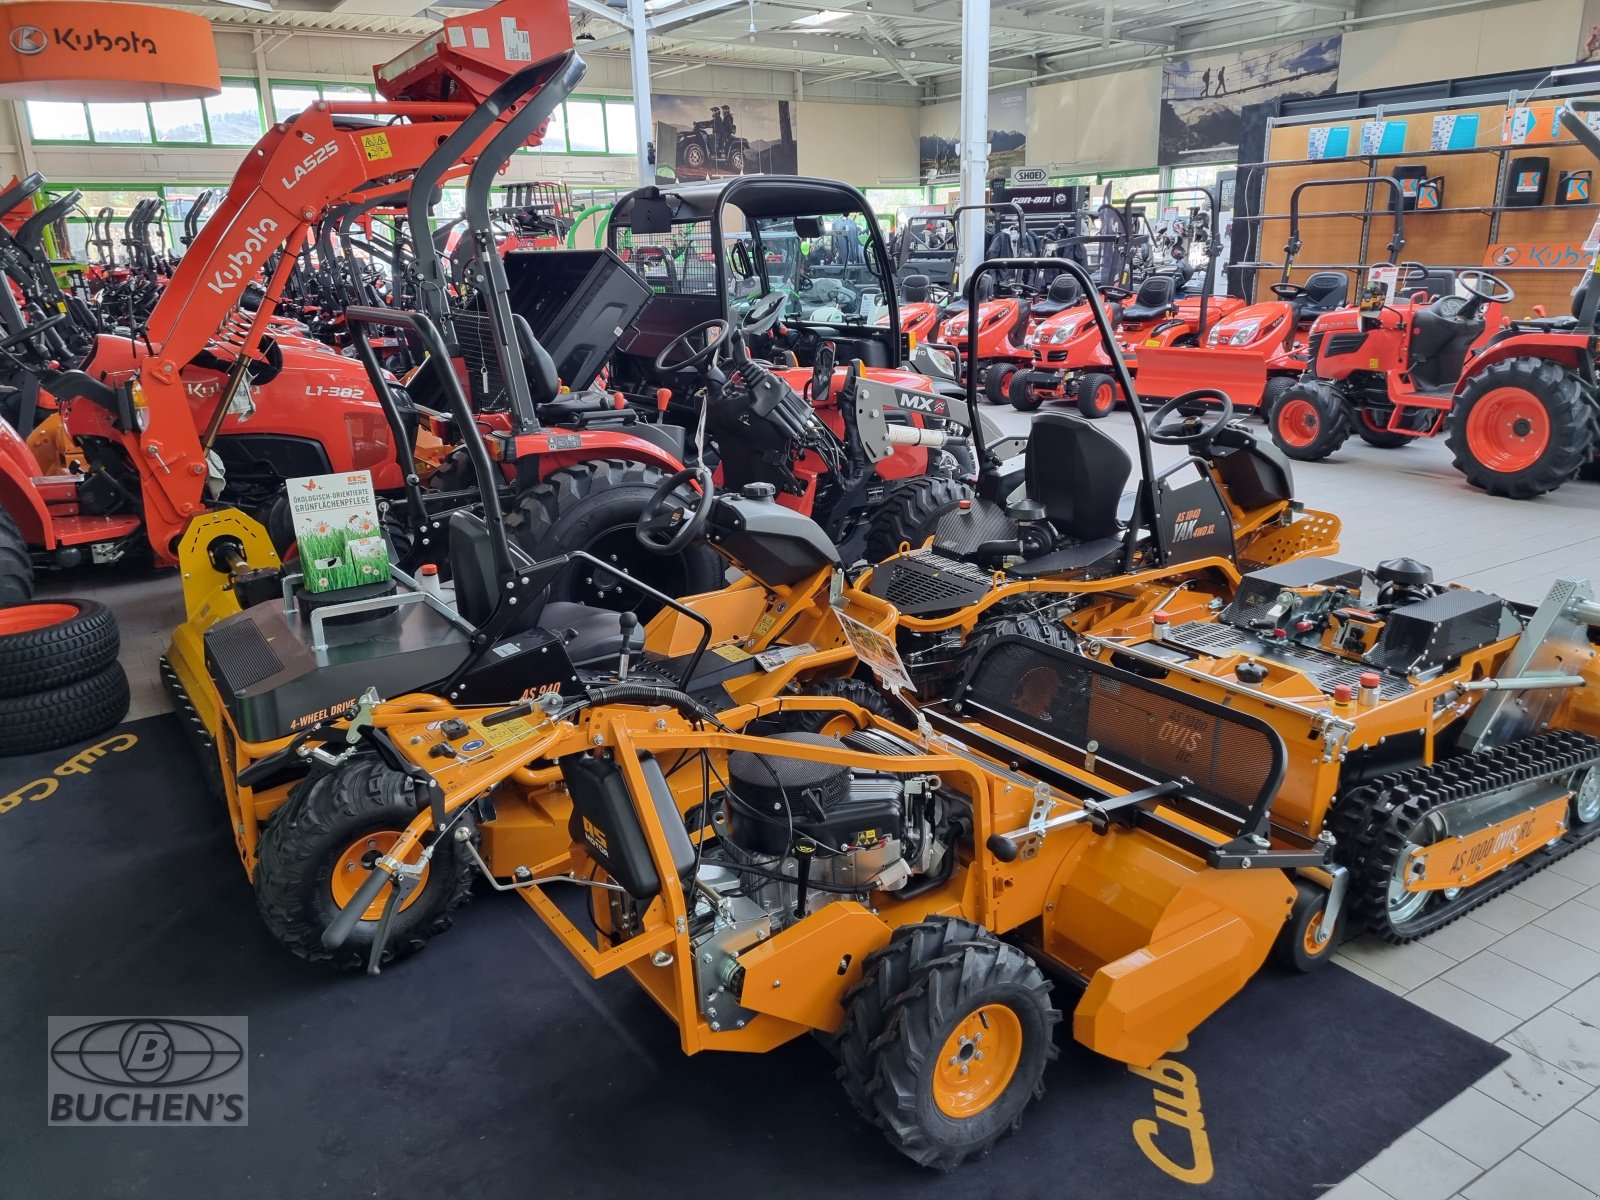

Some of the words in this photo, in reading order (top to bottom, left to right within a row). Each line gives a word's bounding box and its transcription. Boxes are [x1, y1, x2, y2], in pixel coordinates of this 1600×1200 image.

[53, 28, 158, 55] Kubota
[281, 140, 339, 190] LA525
[1019, 172, 1042, 180] SHOEI
[1011, 196, 1052, 204] can-am
[207, 218, 279, 294] Kubota
[305, 386, 365, 399] L1-382
[900, 393, 935, 412] MX
[293, 489, 369, 504] ÖKOLOGISCH-ORIENTIERTE
[295, 496, 370, 512] GRÜNFLÄCHENPFLEGE
[1176, 511, 1186, 523] AS
[1172, 519, 1198, 542] YAK
[520, 687, 537, 701] AS
[539, 682, 561, 696] 940
[290, 708, 328, 730] 4-WHEEL
[331, 698, 356, 716] DRIVE
[1159, 721, 1202, 751] OVIS
[53, 733, 138, 775] Cub
[585, 831, 609, 858] MOTOR
[1449, 849, 1468, 875] AS
